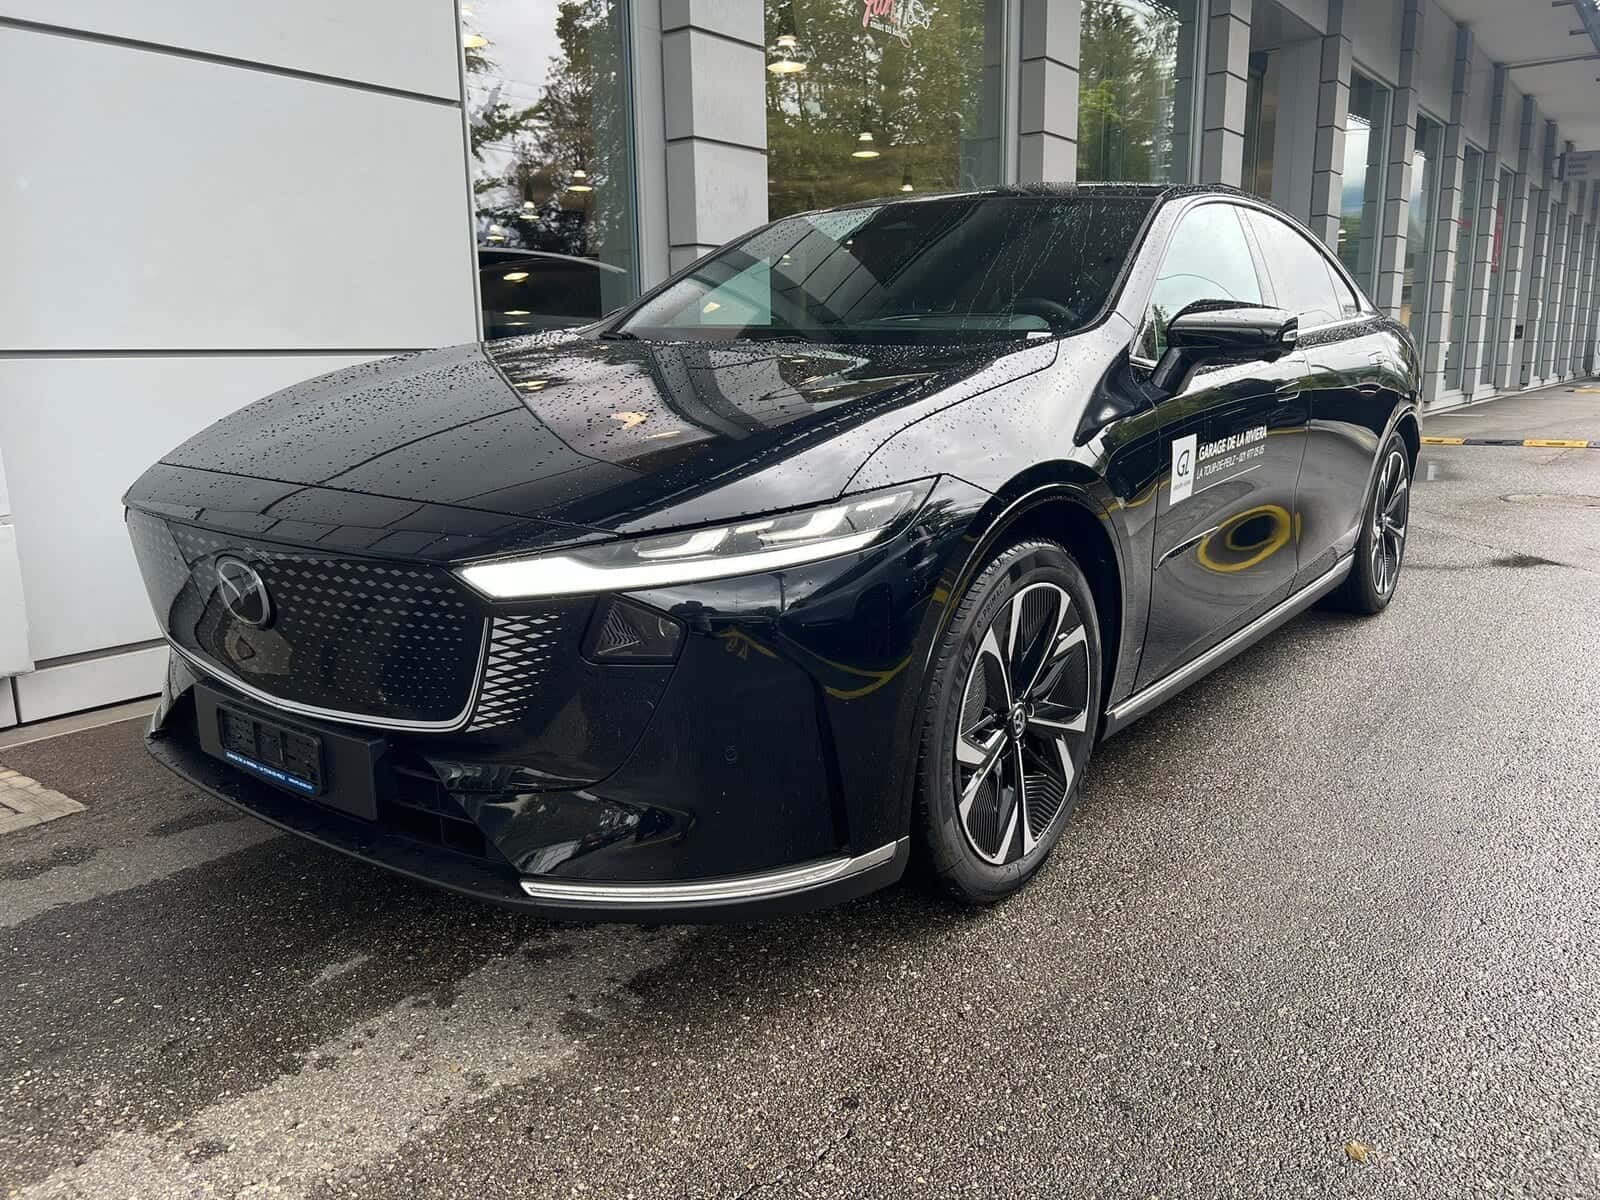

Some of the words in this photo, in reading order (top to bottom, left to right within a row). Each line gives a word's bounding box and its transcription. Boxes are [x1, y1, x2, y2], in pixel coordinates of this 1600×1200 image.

[1199, 438, 1226, 460] GARAGE
[1227, 435, 1236, 450] DE
[1236, 432, 1245, 447] LA
[1245, 424, 1267, 443] RIVIERA
